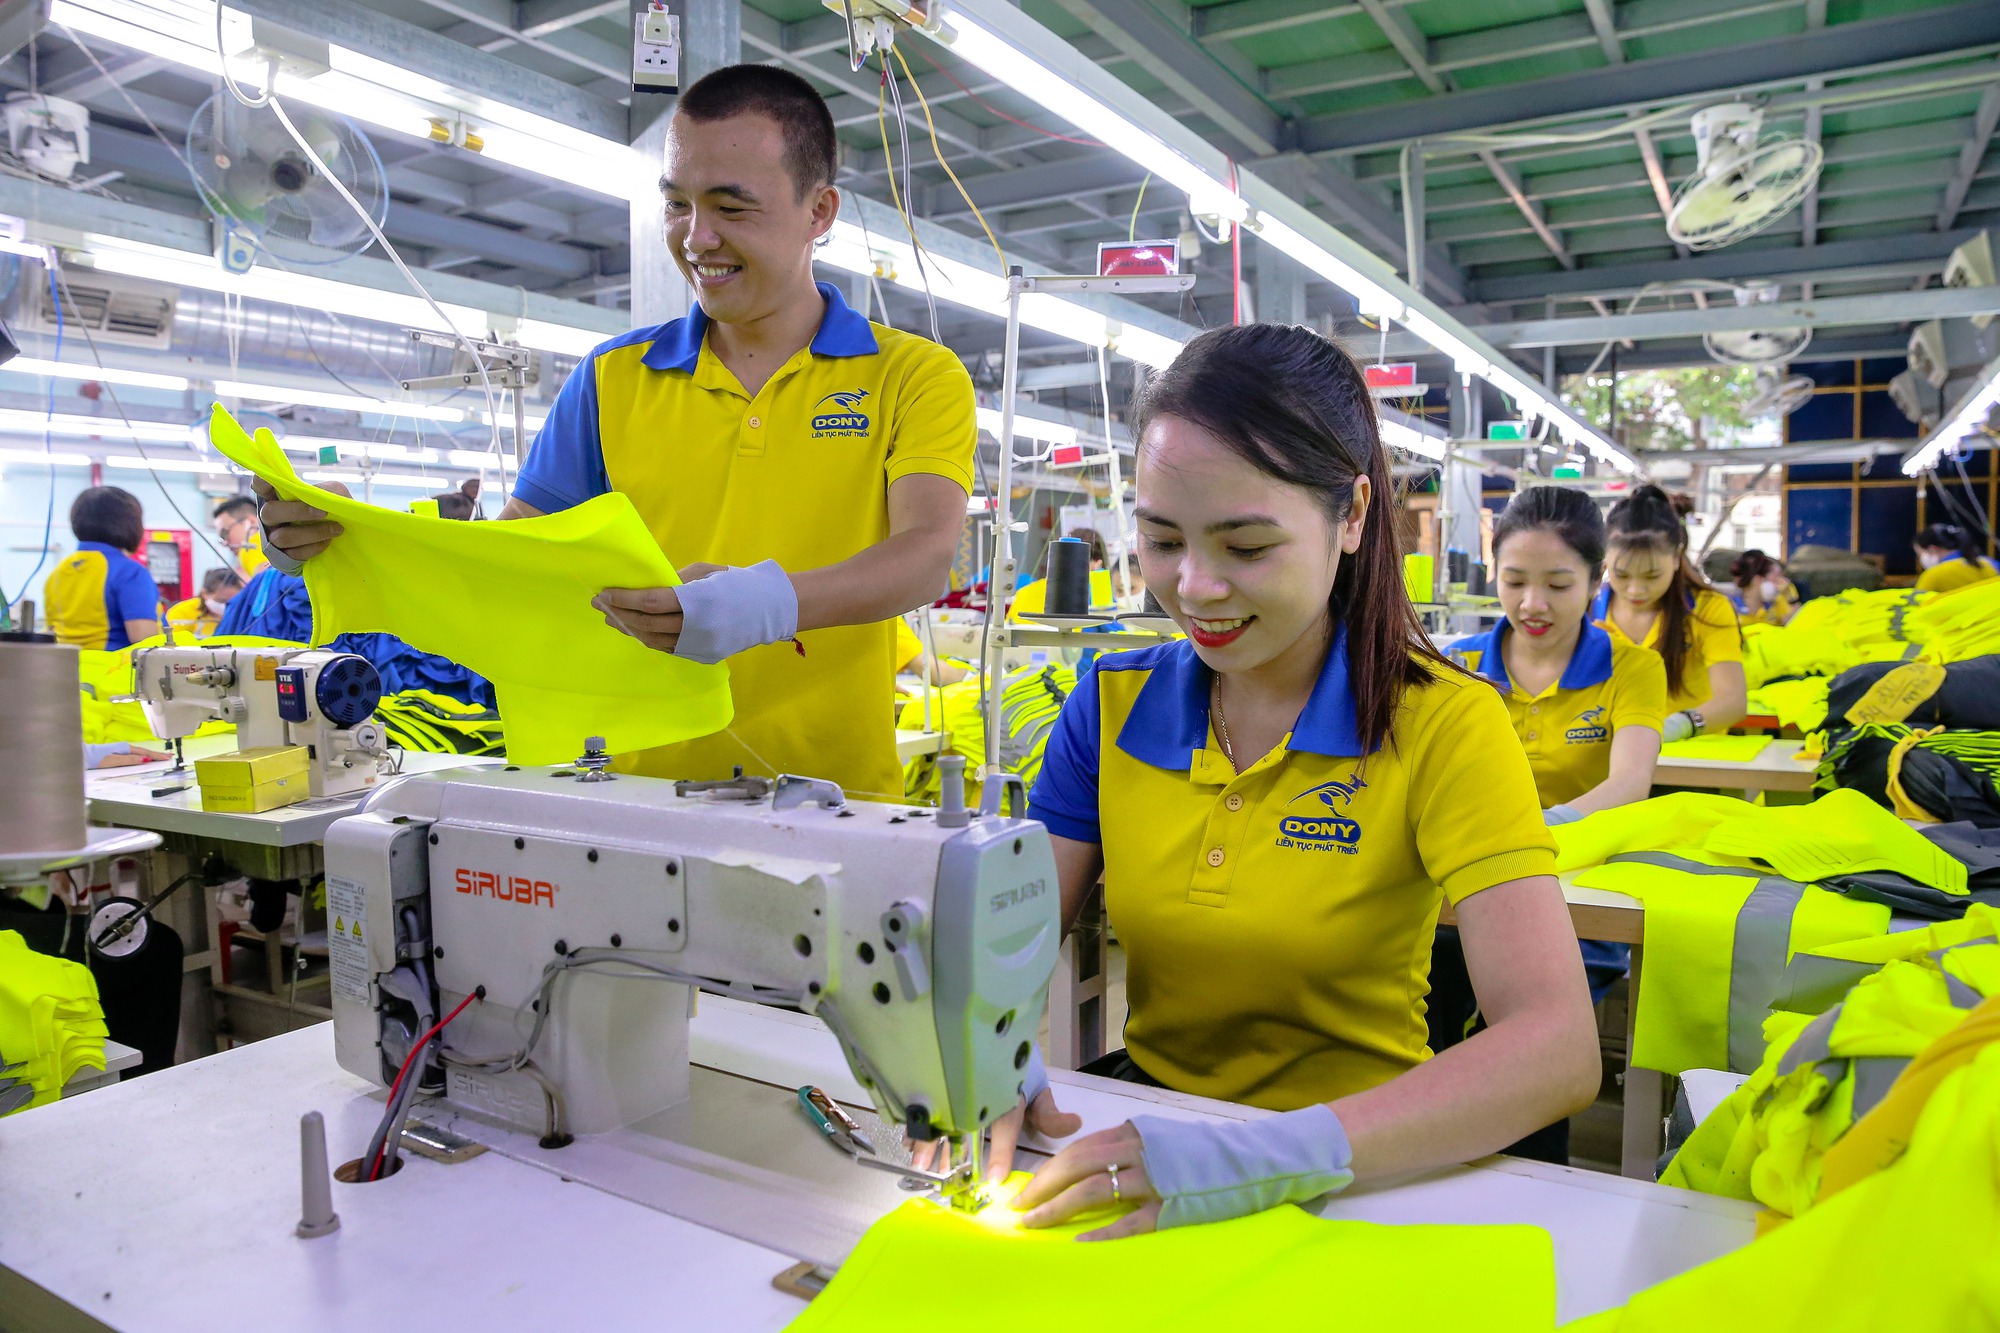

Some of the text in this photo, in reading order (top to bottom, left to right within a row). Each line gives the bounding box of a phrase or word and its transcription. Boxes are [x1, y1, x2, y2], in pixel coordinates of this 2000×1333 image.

[815, 416, 866, 428] DONY
[1284, 820, 1356, 838] DONY
[1275, 836, 1360, 855] LIÊN TỤC PHÁT TRIỂN
